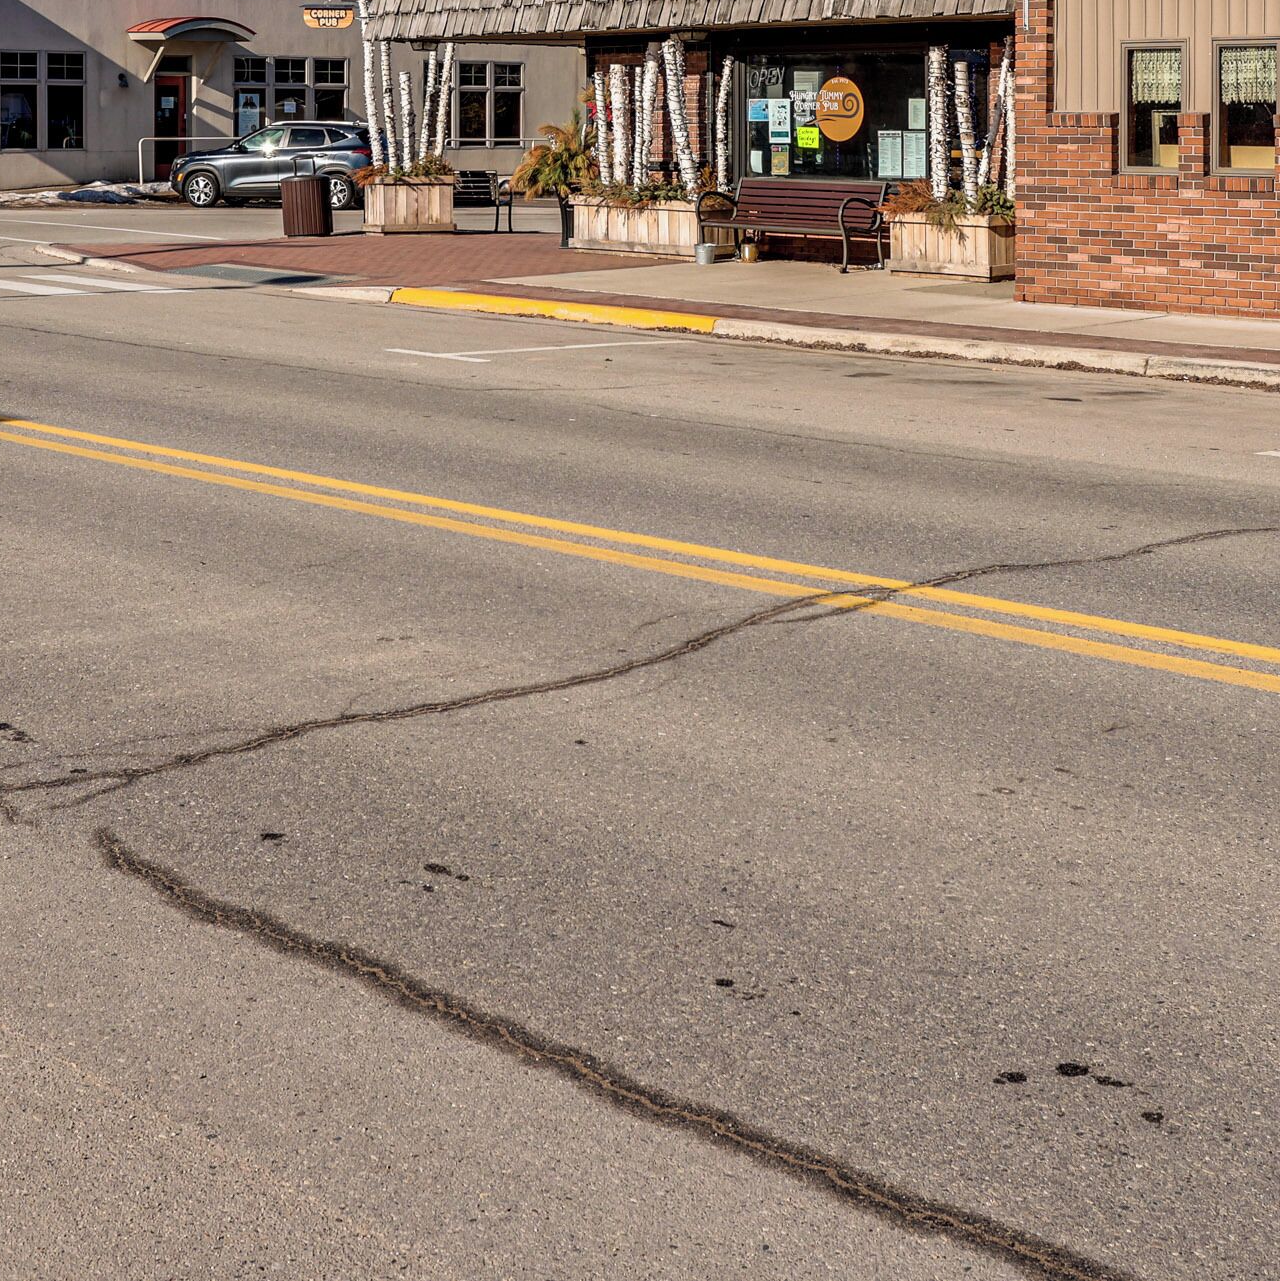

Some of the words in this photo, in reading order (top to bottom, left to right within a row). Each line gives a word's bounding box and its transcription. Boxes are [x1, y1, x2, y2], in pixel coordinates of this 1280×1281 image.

[310, 9, 347, 18] CORNER
[319, 18, 338, 27] PUB
[749, 66, 785, 88] OPEN
[789, 90, 818, 102] HUNGRY
[819, 90, 844, 102] TUMMY
[793, 101, 820, 113] CORNER
[822, 101, 839, 113] PUB
